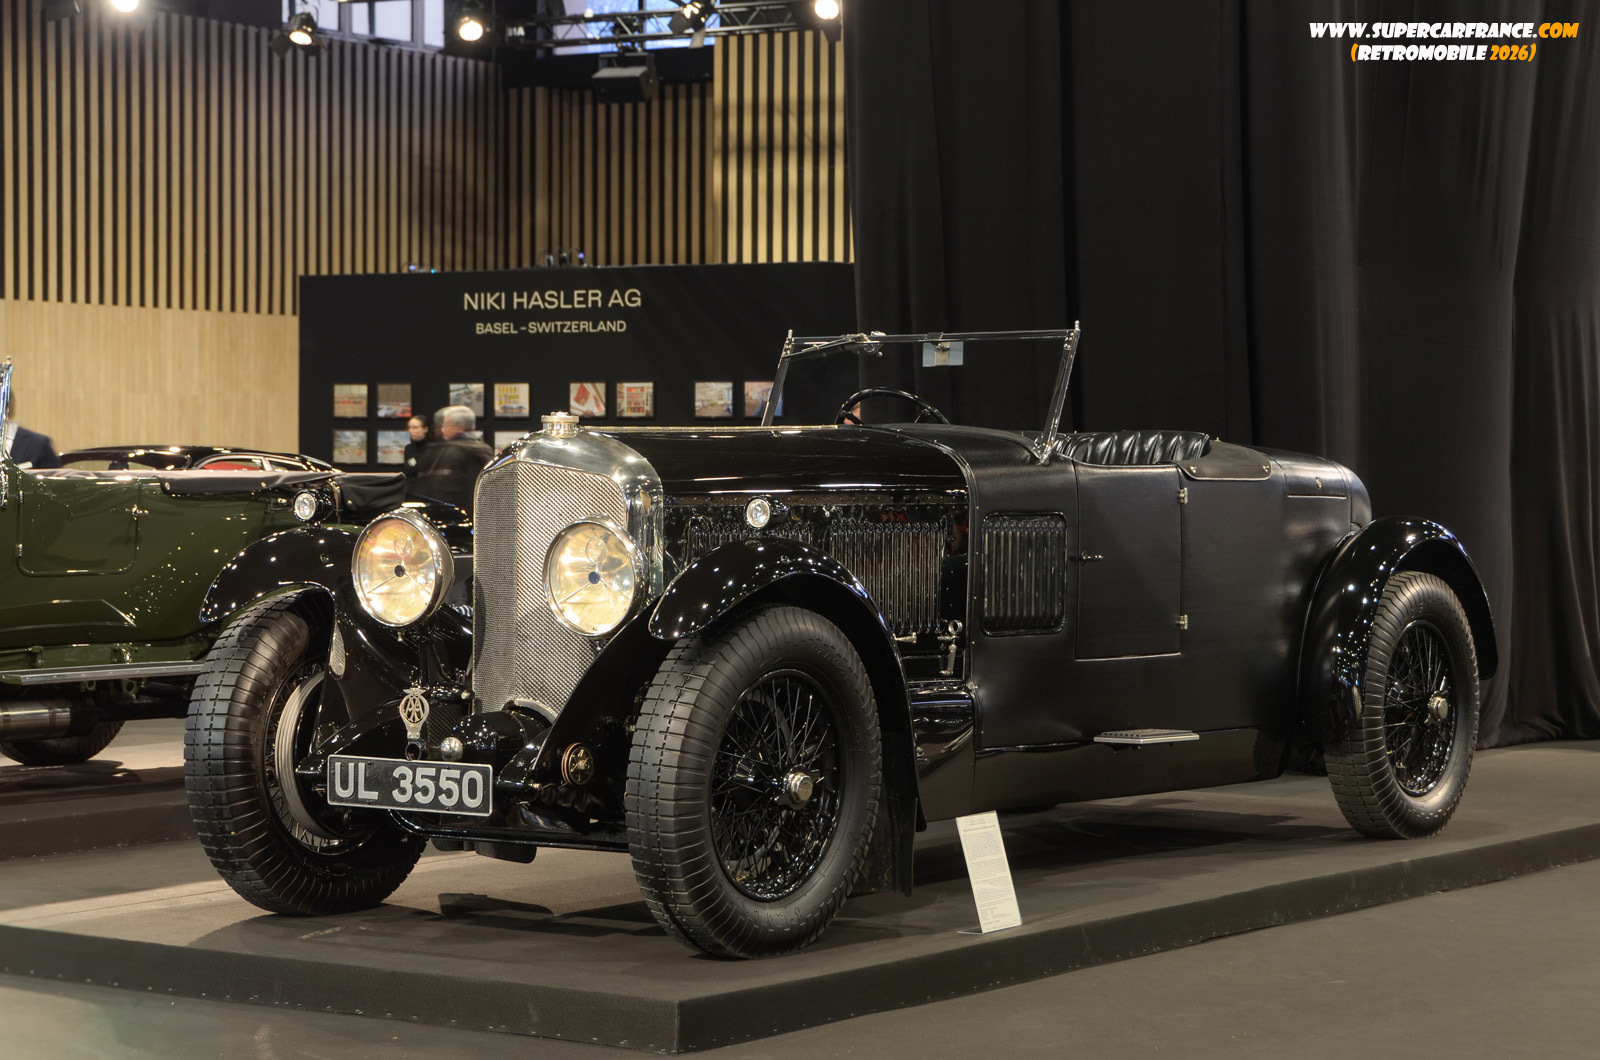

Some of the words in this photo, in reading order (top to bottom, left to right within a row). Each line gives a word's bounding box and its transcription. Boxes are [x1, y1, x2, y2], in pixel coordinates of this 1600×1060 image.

[464, 292, 505, 310] NIKI
[513, 290, 602, 309] HASLER
[608, 288, 642, 307] AG
[476, 322, 518, 334] BASEL
[334, 762, 379, 800] UL
[391, 765, 484, 808] 3550
